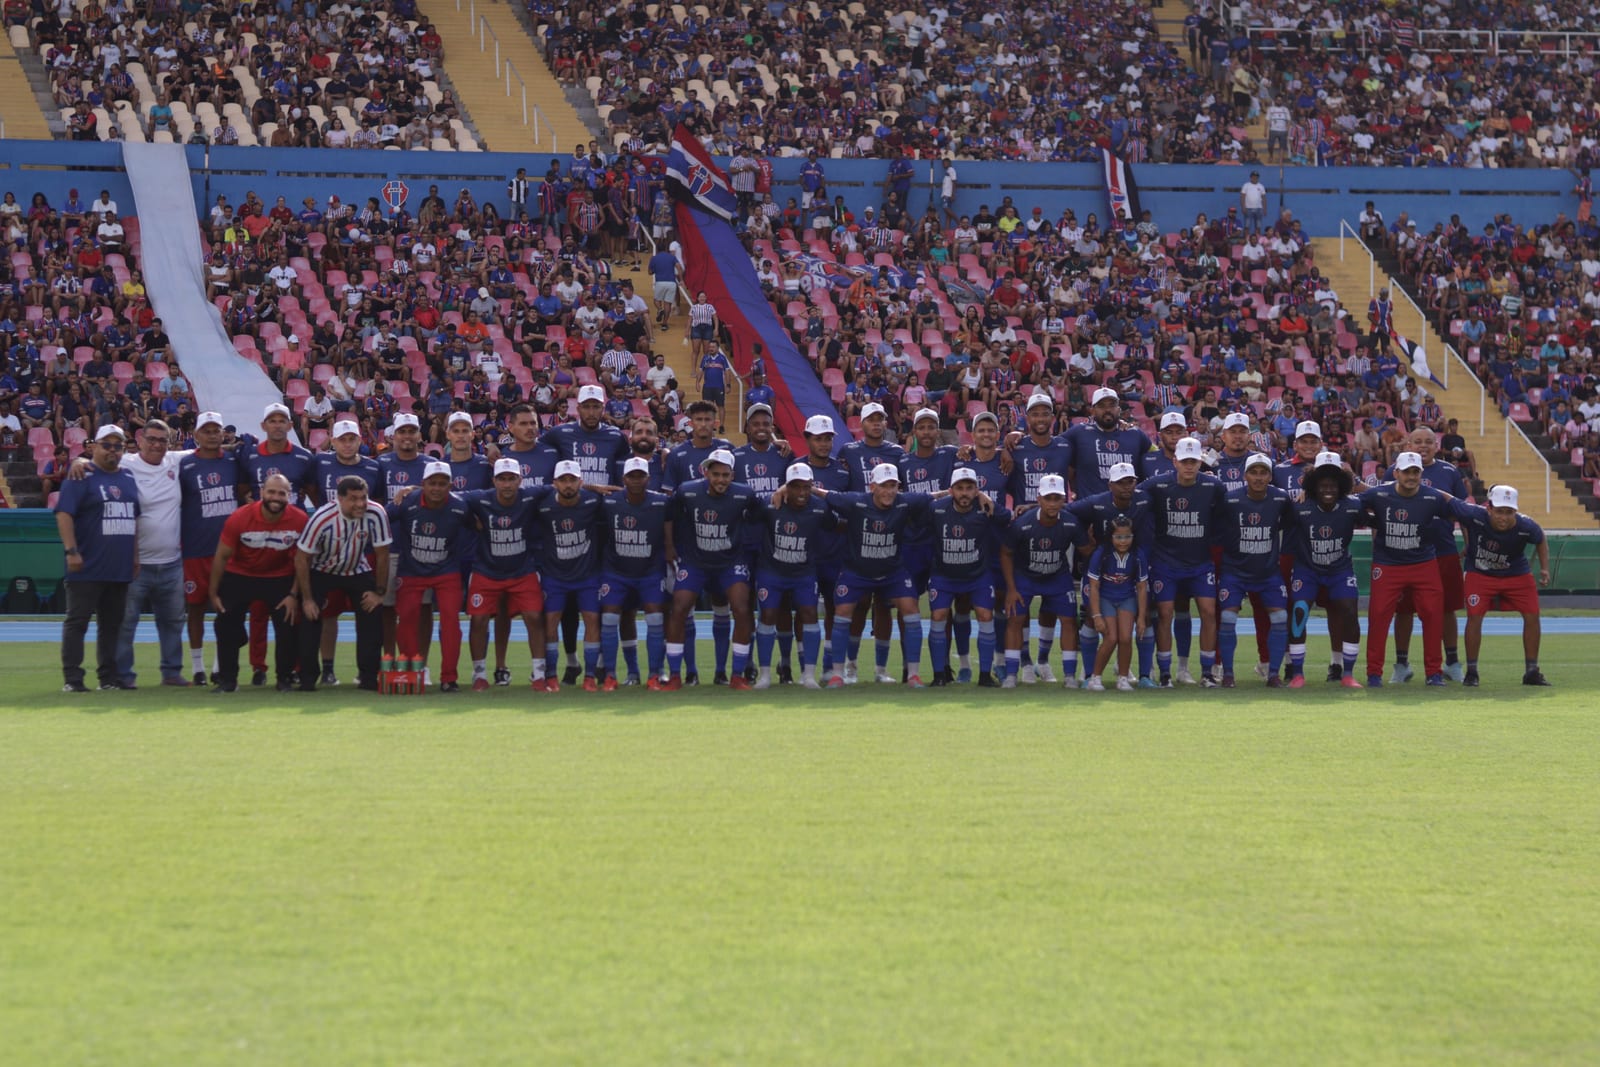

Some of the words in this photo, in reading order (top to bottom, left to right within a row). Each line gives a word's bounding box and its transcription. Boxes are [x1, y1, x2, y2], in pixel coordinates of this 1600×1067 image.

[598, 457, 608, 471] DE
[1097, 452, 1123, 465] TEMPO
[770, 478, 779, 490] DE
[200, 487, 225, 503] TEMPO
[225, 485, 234, 500] DE
[1168, 512, 1190, 524] TEMPO
[1191, 512, 1199, 524] DE
[490, 529, 513, 542] TEMPO
[514, 528, 522, 541] DE
[695, 523, 719, 537] TEMPO
[719, 524, 728, 537] DE
[1240, 527, 1263, 540] TEMPO
[1263, 526, 1271, 539] DE
[1386, 522, 1409, 535] TEMPO
[1410, 524, 1419, 536] DE
[411, 535, 435, 550] TEMPO
[436, 538, 446, 550] DE
[555, 532, 578, 546] TEMPO
[578, 529, 586, 543] DE
[615, 529, 638, 543] TEMPO
[638, 530, 648, 544] DE
[775, 534, 797, 549] TEMPO
[797, 537, 807, 550] DE
[863, 532, 885, 545] TEMPO
[886, 533, 895, 545] DE
[942, 538, 967, 552] TEMPO
[967, 538, 976, 551] DE
[1311, 540, 1334, 553] TEMPO
[1334, 538, 1343, 551] DE
[1030, 551, 1052, 562] TEMPO
[1053, 551, 1060, 562] DE
